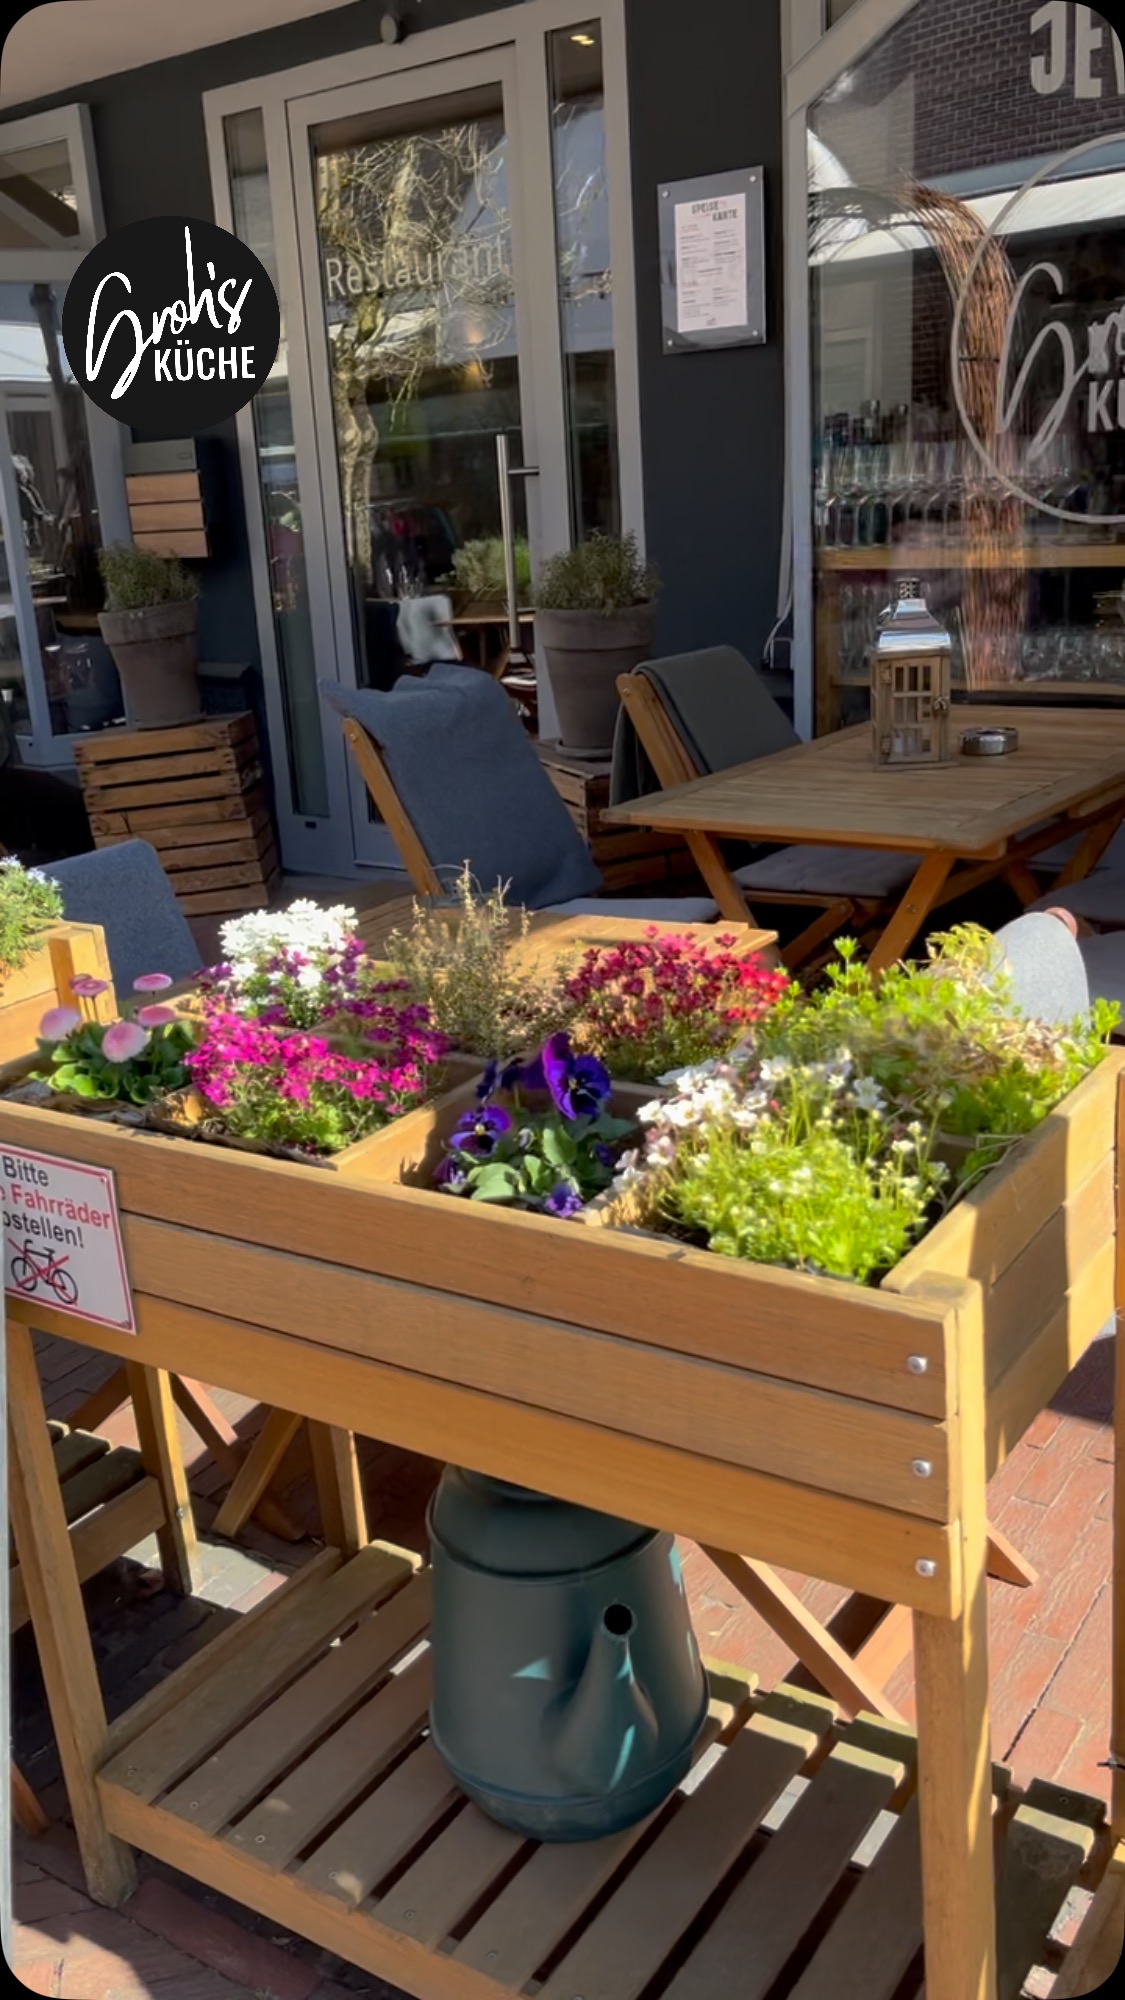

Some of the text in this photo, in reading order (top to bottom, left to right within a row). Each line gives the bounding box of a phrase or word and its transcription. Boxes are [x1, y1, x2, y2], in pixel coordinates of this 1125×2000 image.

[712, 208, 738, 221] KARTE
[2, 1155, 49, 1187] Bitte
[11, 1183, 110, 1230] Fahrräder
